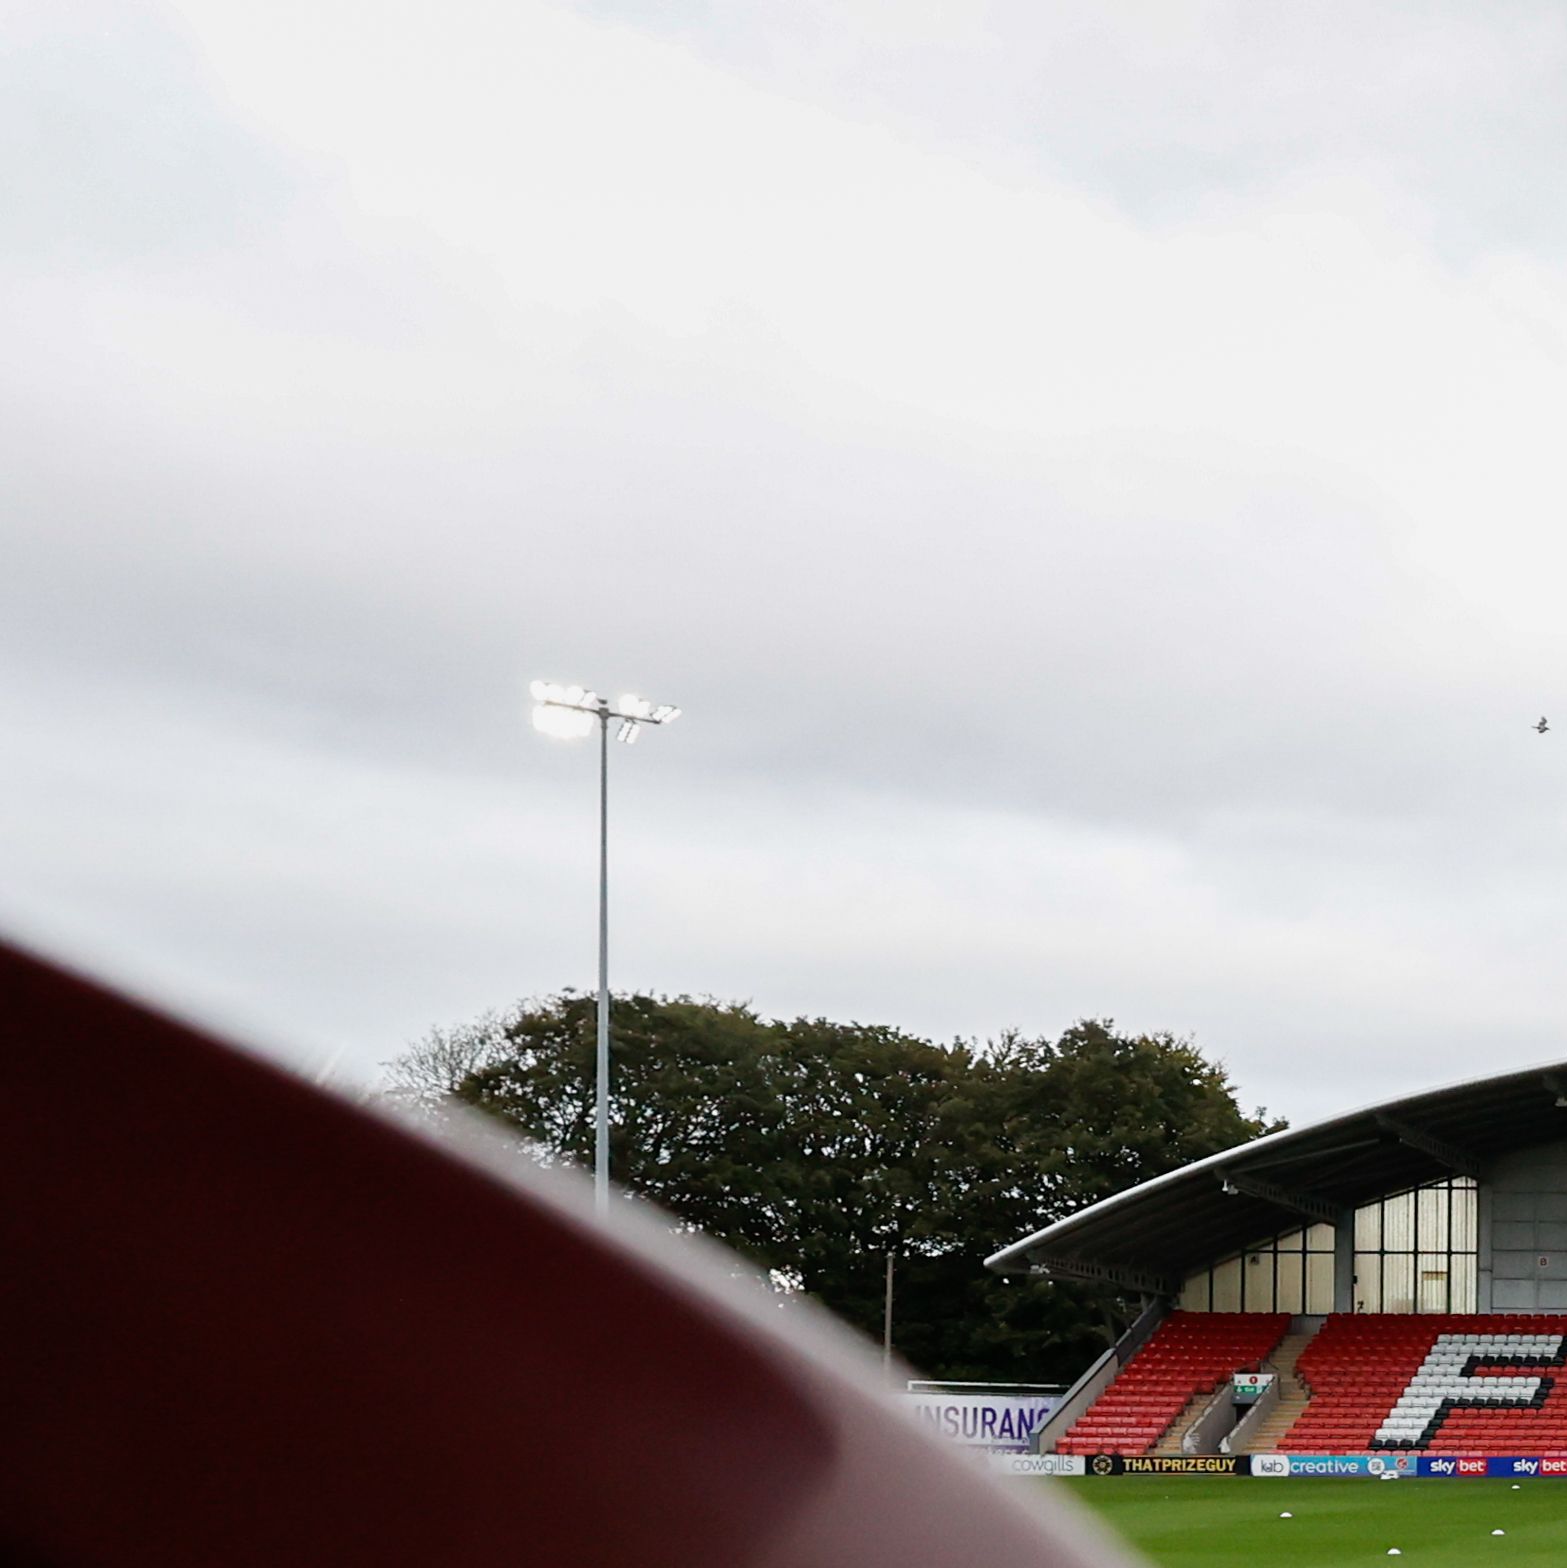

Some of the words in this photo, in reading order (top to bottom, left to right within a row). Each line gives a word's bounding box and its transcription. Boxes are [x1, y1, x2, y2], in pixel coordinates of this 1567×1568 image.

[1012, 1456, 1074, 1475] cowgills
[1122, 1458, 1237, 1472] THATPRIZEGUY
[1290, 1459, 1359, 1473] creative
[1430, 1459, 1456, 1475] sky
[1459, 1458, 1486, 1472] bet
[1513, 1459, 1539, 1475] sky
[1542, 1458, 1567, 1472] bet
